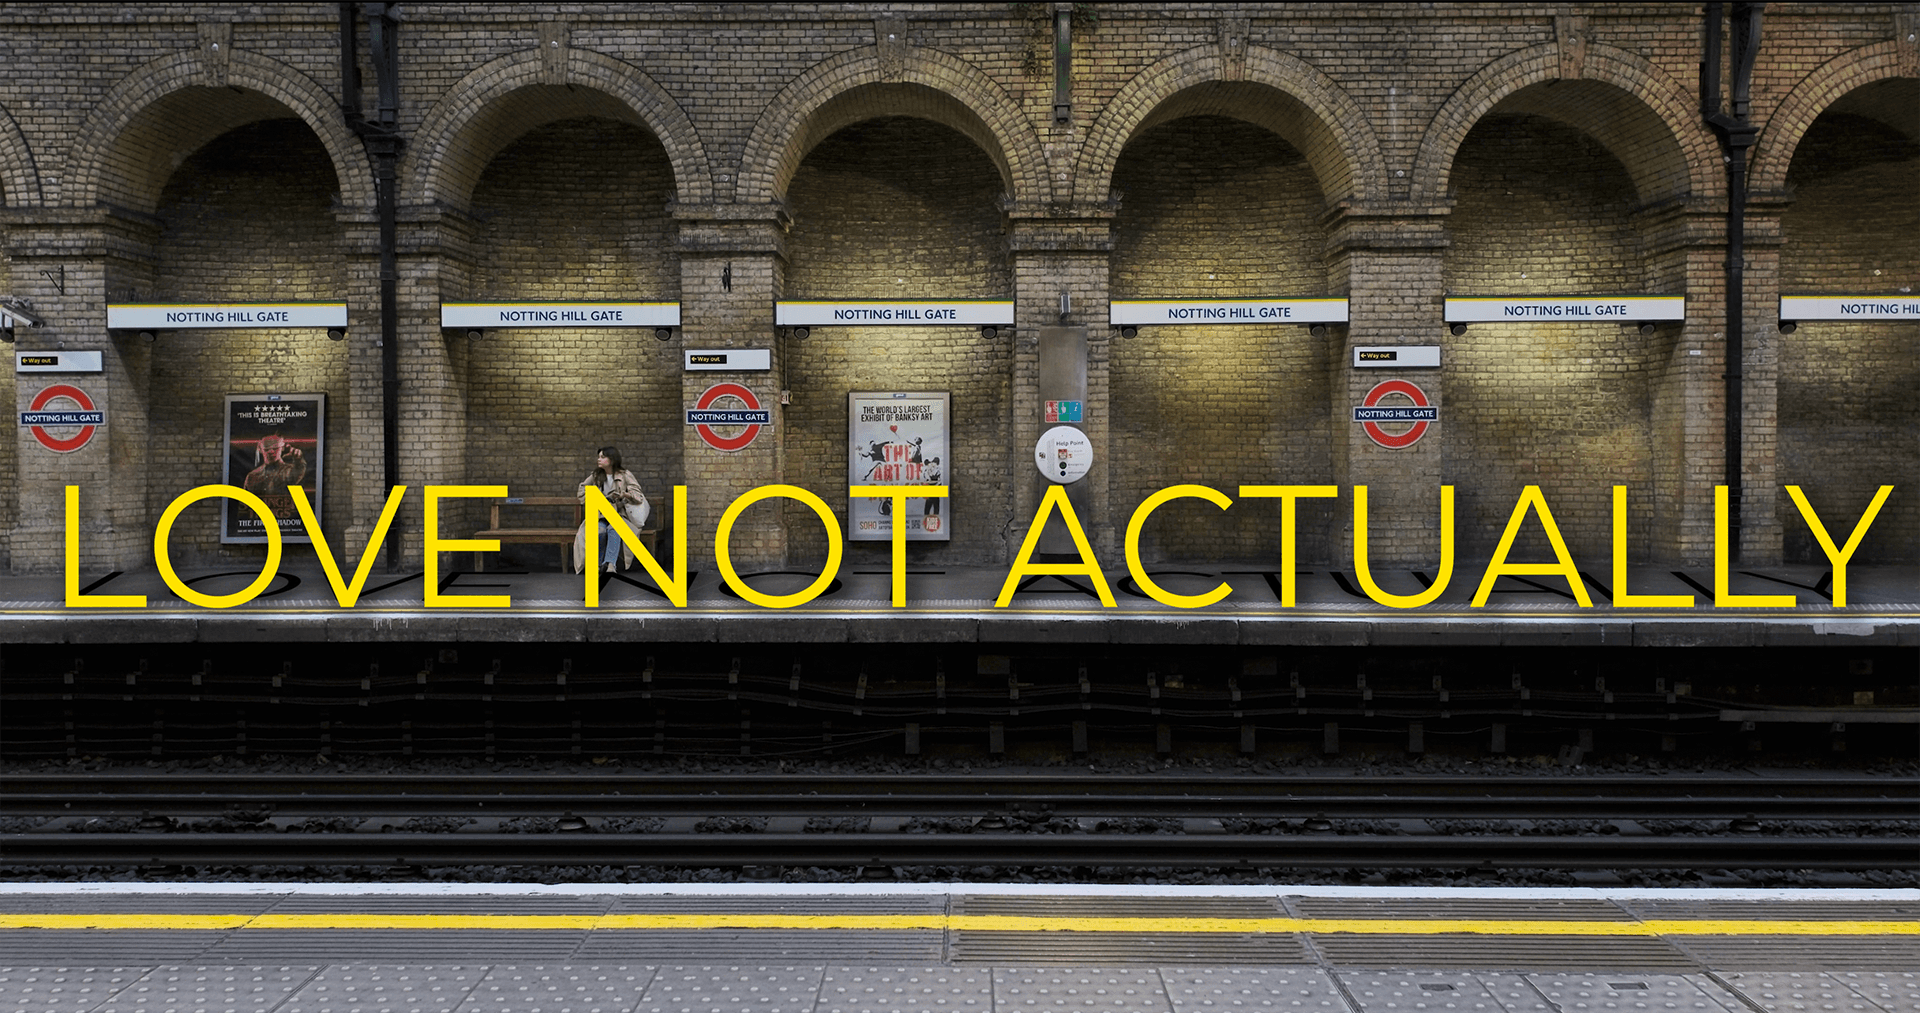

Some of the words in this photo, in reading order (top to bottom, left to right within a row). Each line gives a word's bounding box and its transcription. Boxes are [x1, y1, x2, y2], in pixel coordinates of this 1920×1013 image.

[835, 309, 891, 319] NOTTING
[896, 309, 921, 319] HILL
[925, 309, 956, 319] GATE
[1169, 308, 1225, 318] NOTTING
[1230, 308, 1255, 318] HILL
[1259, 307, 1290, 318] GATE
[1505, 306, 1561, 316] NOTTING
[1566, 306, 1591, 316] HILL
[1595, 305, 1627, 315] GATE
[1841, 304, 1898, 314] NOTTING
[167, 312, 224, 322] NOTTING
[228, 312, 253, 322] HILL
[257, 312, 288, 322] GATE
[501, 311, 557, 321] NOTTING
[562, 311, 587, 321] HILL
[591, 311, 622, 321] GATE
[863, 406, 874, 414] THE
[876, 405, 902, 413] WORLD'S
[904, 405, 931, 413] LARGEST
[861, 414, 884, 422] EXHIBIT
[886, 413, 894, 421] OF
[895, 413, 919, 421] BANKSY
[920, 413, 933, 421] ART
[873, 463, 902, 481] ART
